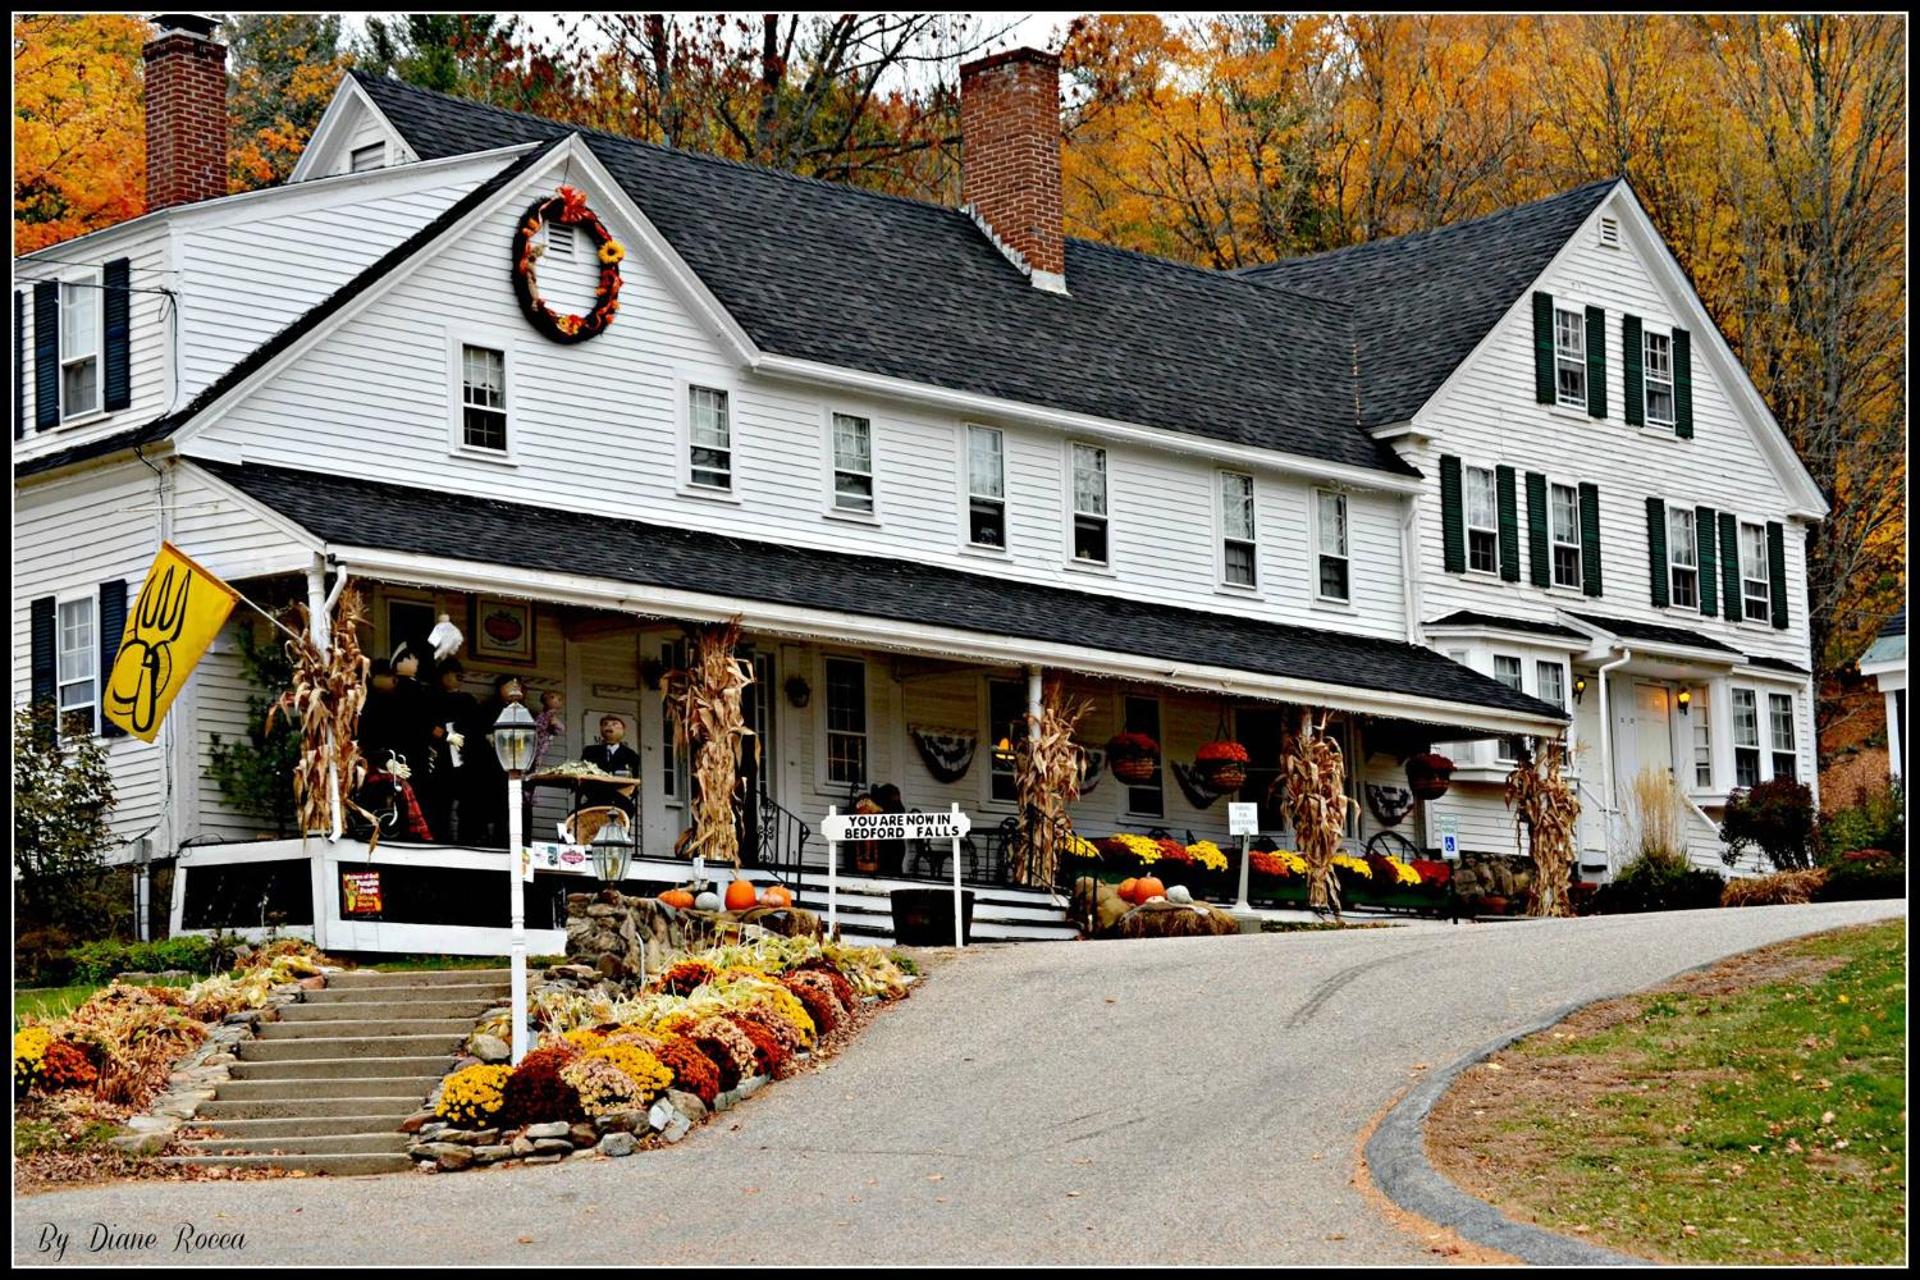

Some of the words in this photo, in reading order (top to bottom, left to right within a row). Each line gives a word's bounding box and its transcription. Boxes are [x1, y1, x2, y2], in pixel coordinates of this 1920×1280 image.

[849, 816, 877, 827] YOU
[880, 815, 903, 826] ARE
[906, 814, 934, 825] NOW
[937, 814, 951, 825] IN
[845, 827, 905, 839] BEDFORD
[916, 826, 960, 837] FALLS
